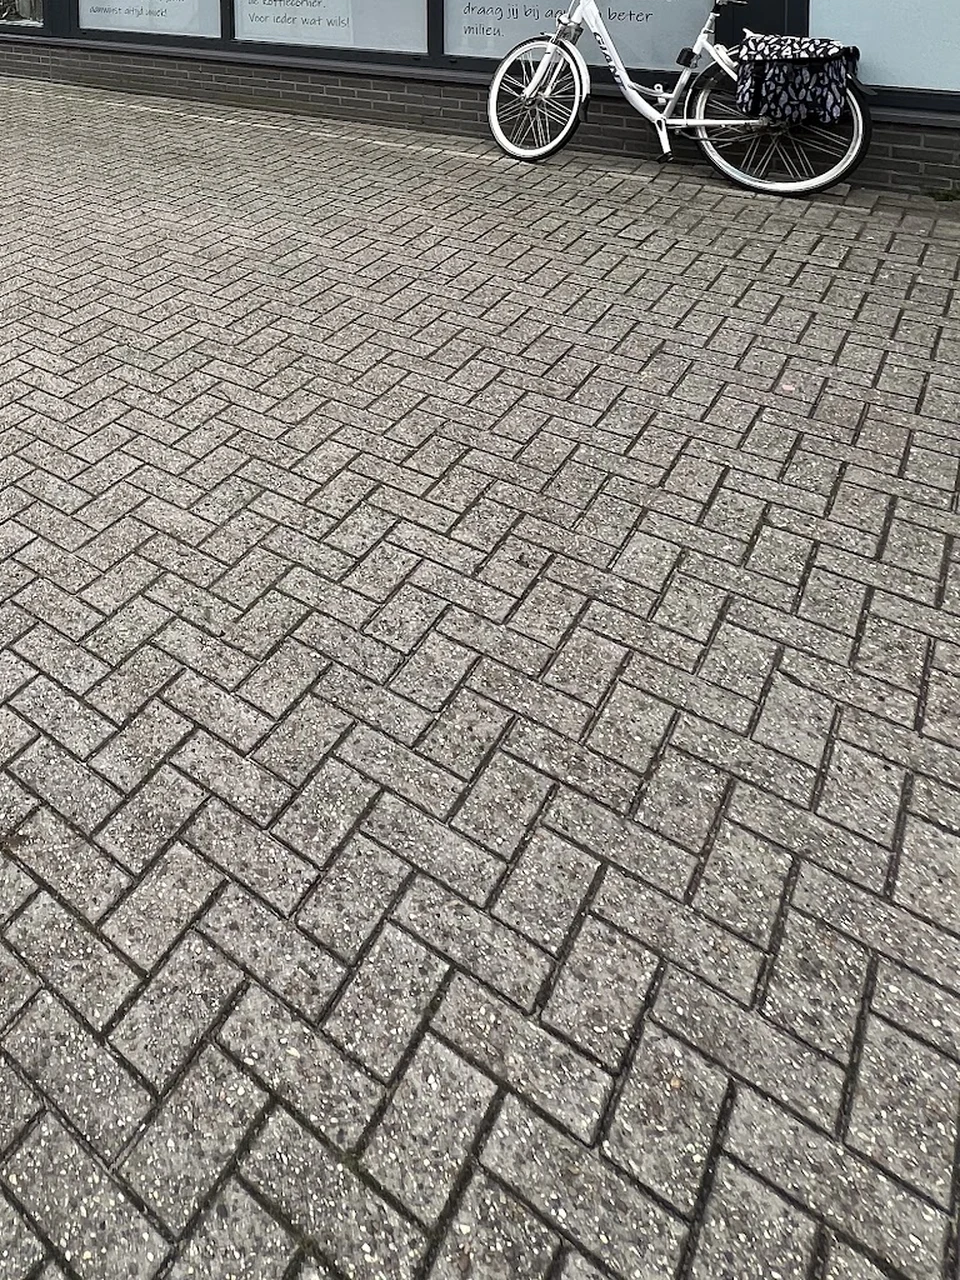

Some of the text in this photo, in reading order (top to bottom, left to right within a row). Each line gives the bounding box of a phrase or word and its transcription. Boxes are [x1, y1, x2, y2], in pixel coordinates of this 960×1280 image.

[248, 12, 350, 28] Voor ieder wat wils!
[463, 2, 504, 21] draag
[506, 6, 519, 19] jij
[523, 4, 540, 20] bij
[608, 8, 654, 22] beter
[463, 24, 505, 37] milieu.
